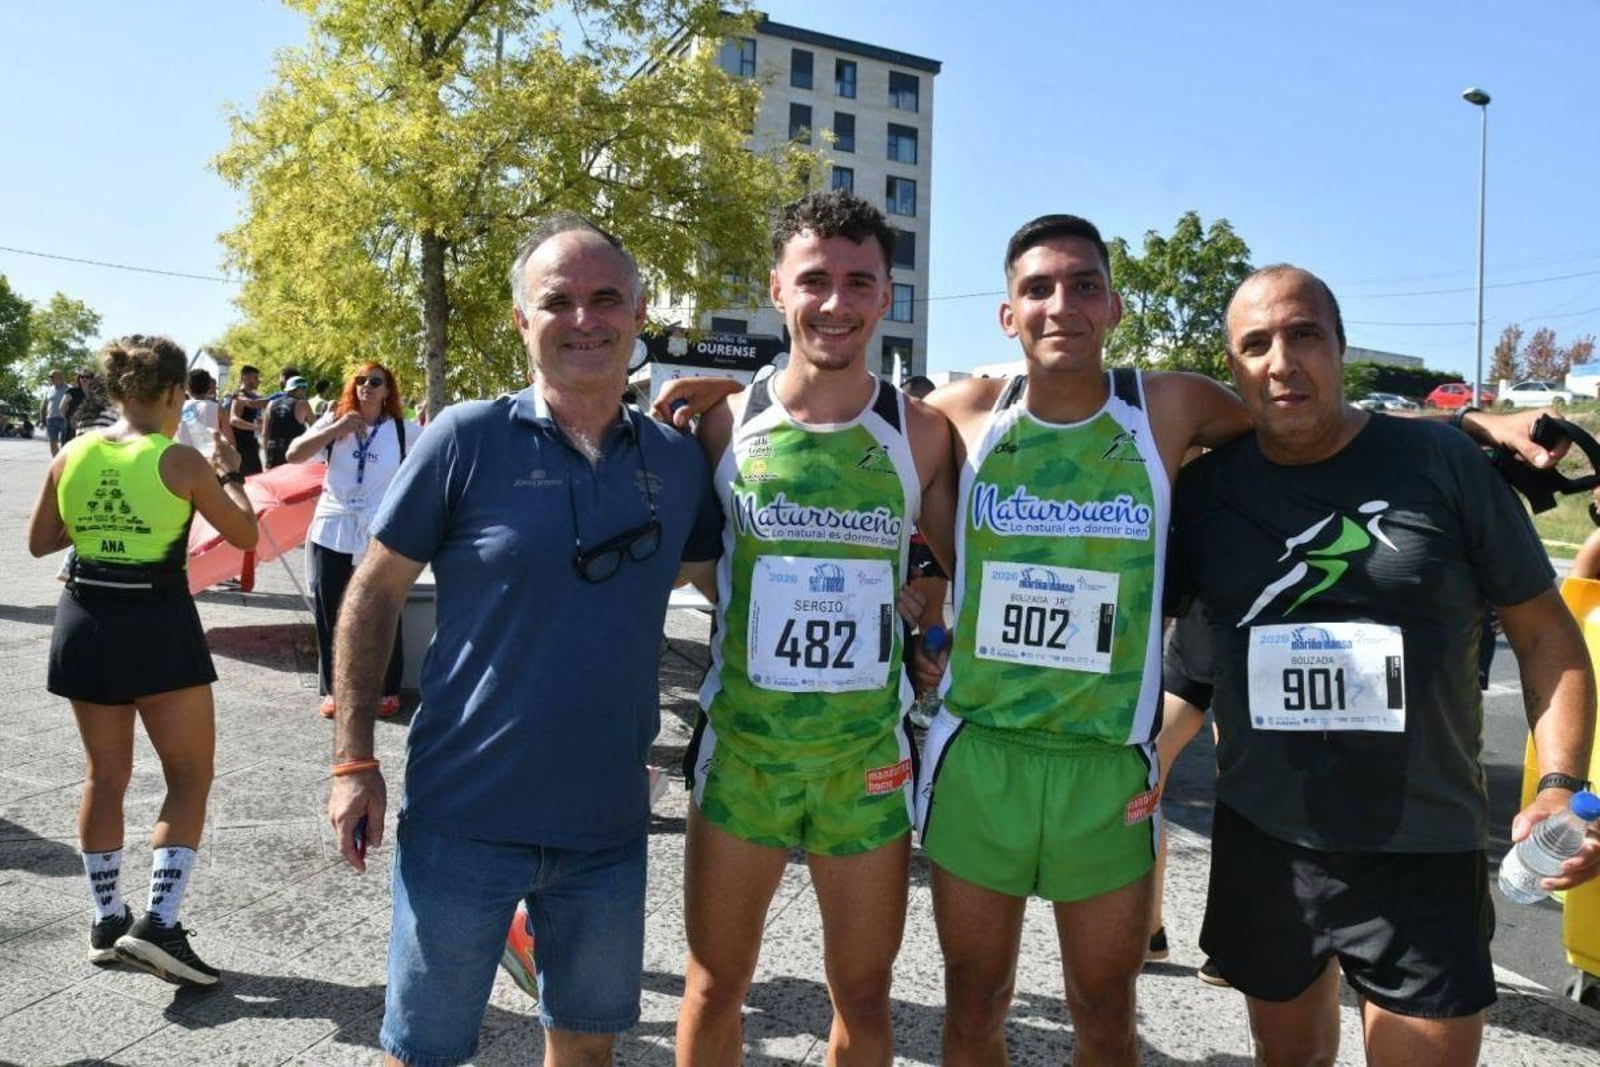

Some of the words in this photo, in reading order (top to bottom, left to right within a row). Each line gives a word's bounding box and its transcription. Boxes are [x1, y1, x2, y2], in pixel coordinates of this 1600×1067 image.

[697, 342, 757, 358] OURENSE
[974, 485, 1150, 532] Natursueño
[735, 494, 901, 538] Natursueño
[788, 528, 826, 538] natural
[829, 531, 841, 540] es
[844, 530, 878, 544] dormir
[1010, 523, 1023, 532] Lo
[1026, 523, 1066, 533] natural
[1084, 524, 1123, 535] dormir
[1126, 526, 1149, 537] bien
[101, 540, 126, 553] ANA
[794, 599, 844, 613] SERGIO
[1002, 603, 1070, 650] 902
[774, 618, 857, 669] 482
[1291, 656, 1335, 665] BOUZADA
[1283, 668, 1346, 711] 901
[90, 868, 119, 881] NEVER
[153, 869, 182, 879] NEVER
[95, 881, 116, 894] GIVE
[152, 882, 174, 893] GIVE
[101, 896, 113, 906] UP
[152, 896, 164, 905] UP
